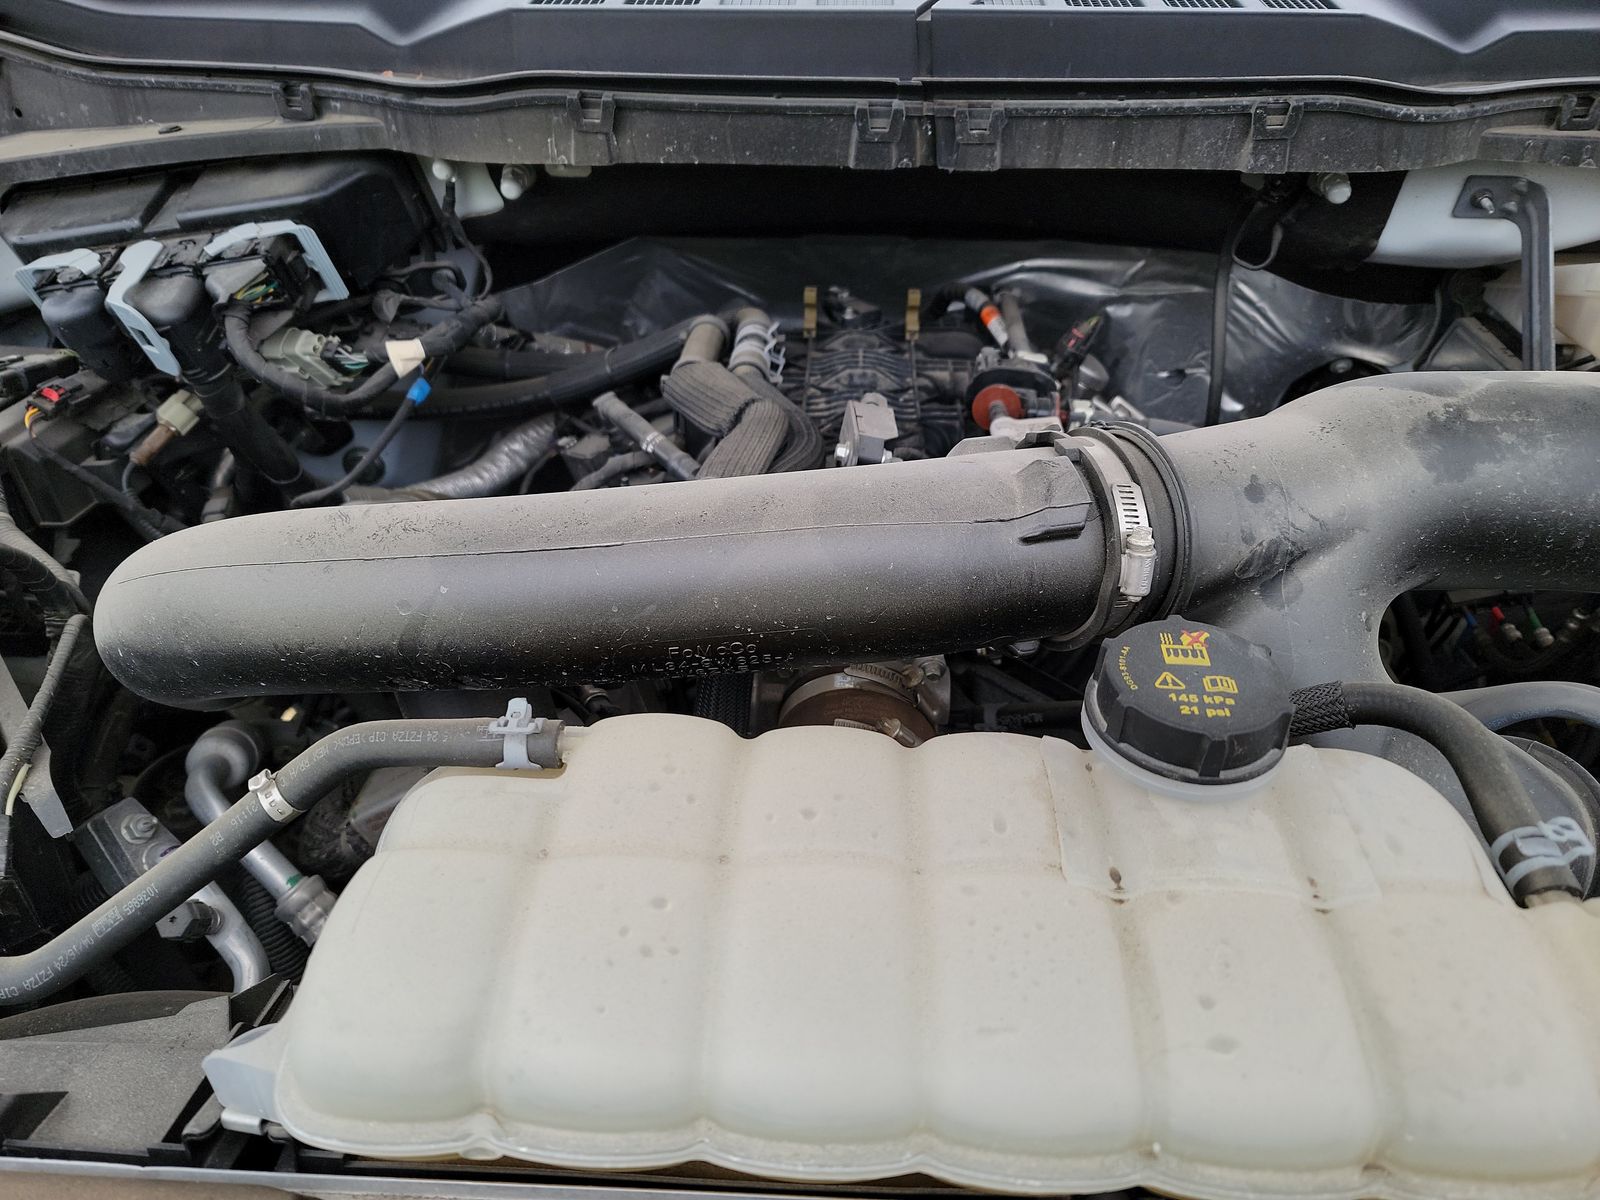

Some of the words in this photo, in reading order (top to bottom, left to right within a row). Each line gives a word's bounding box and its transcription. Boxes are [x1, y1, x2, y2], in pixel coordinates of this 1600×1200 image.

[1168, 693, 1199, 703] 145
[1203, 695, 1236, 705] kPa
[1180, 705, 1200, 715] 21
[1206, 708, 1231, 718] psi
[123, 883, 159, 916] 1036865
